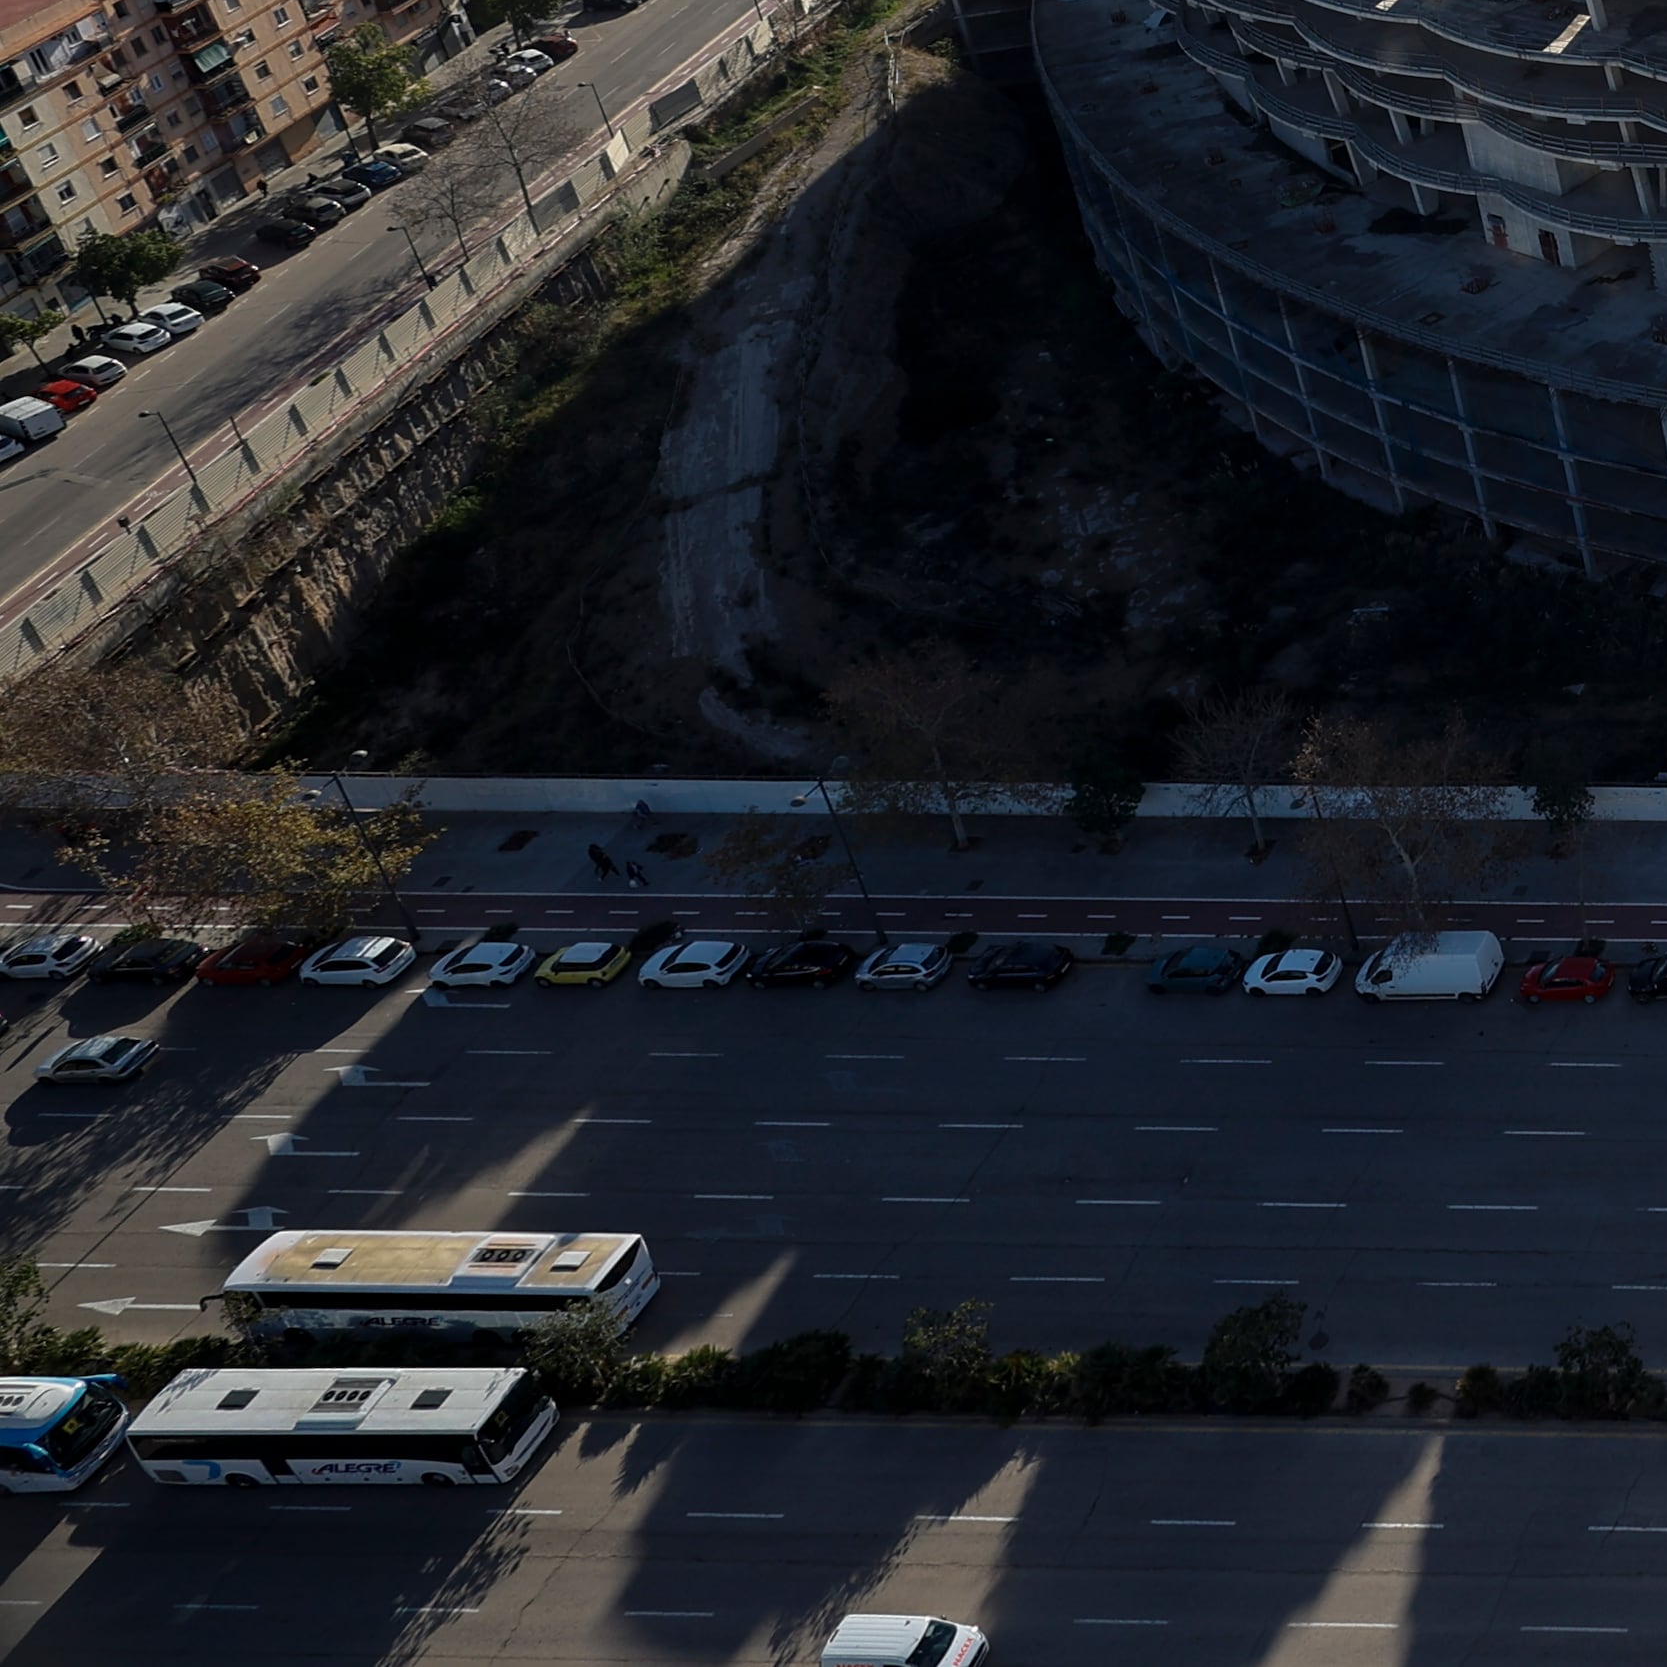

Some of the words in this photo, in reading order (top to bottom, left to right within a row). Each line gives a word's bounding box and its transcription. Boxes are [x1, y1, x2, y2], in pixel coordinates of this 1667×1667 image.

[361, 1316, 442, 1327] ALEGRE
[318, 1463, 398, 1474] ALEGRE
[952, 1637, 975, 1667] NACEX
